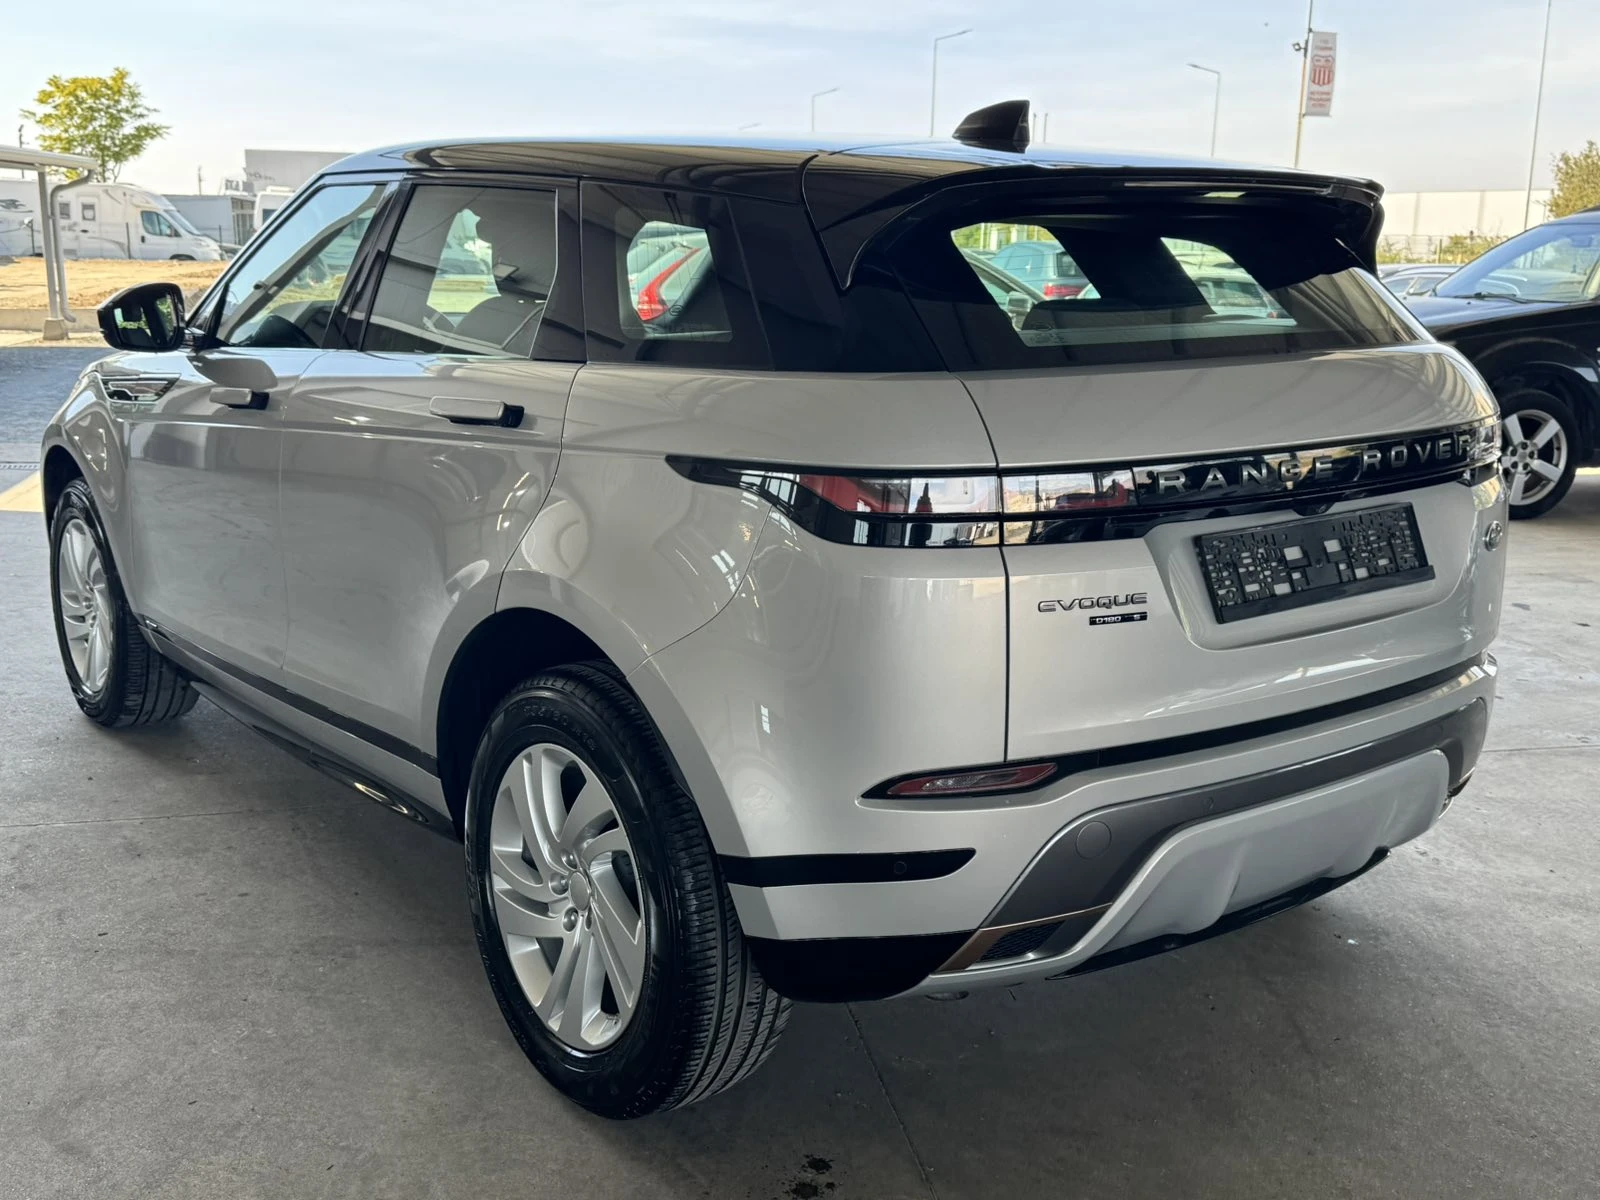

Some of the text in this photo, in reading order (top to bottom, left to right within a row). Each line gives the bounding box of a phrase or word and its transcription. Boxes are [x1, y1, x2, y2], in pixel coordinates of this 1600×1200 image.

[1157, 433, 1472, 494] RANGE ROVER
[1038, 592, 1148, 613] EVOQUE
[1095, 615, 1121, 625] D180
